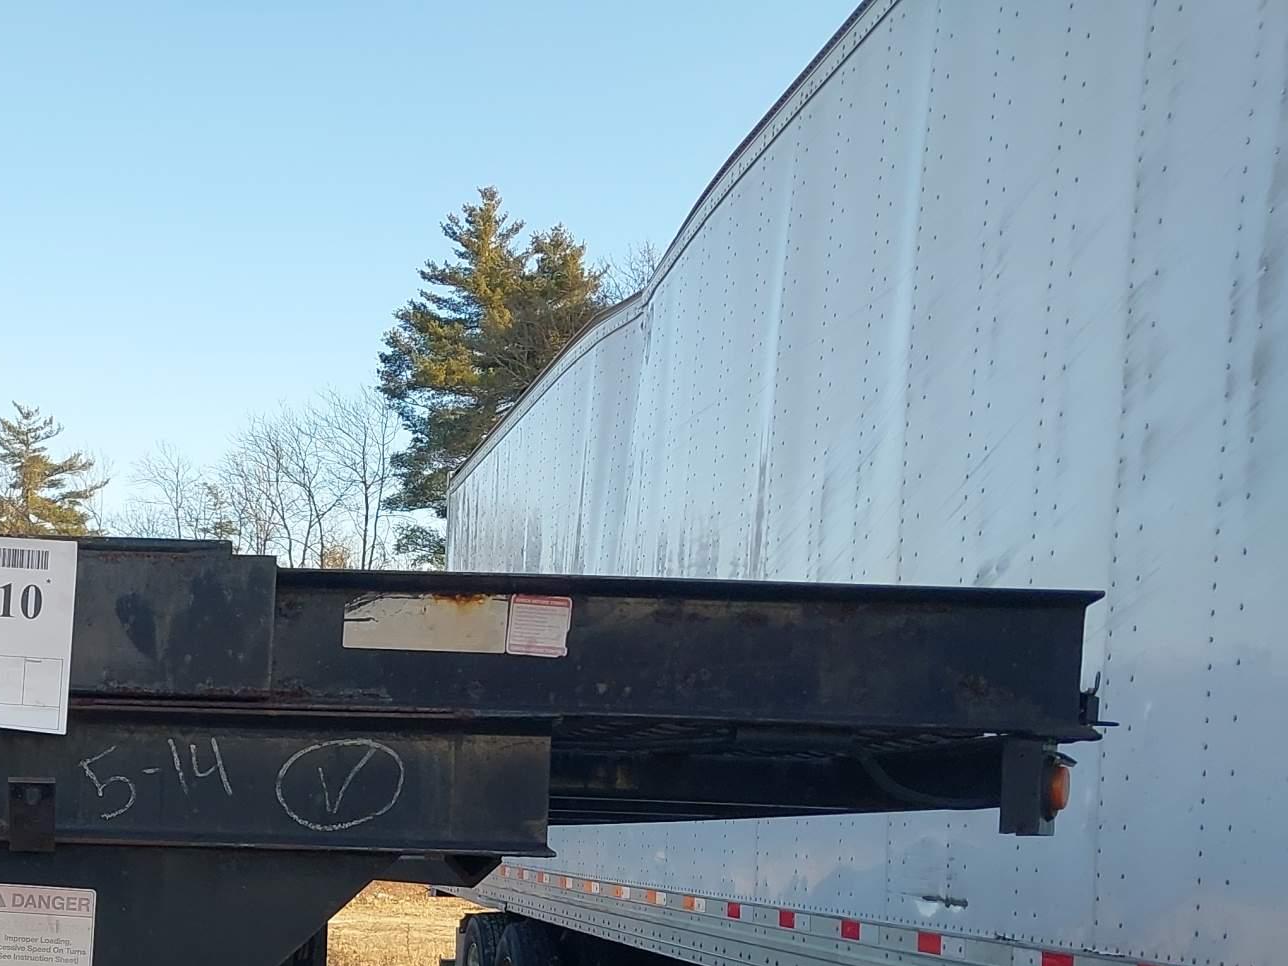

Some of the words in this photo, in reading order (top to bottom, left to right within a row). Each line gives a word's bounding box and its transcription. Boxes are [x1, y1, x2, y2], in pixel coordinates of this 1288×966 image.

[79, 738, 232, 820] 5-14
[12, 893, 90, 912] DANGER
[4, 934, 38, 944] Improper
[27, 945, 51, 954] Speed
[66, 947, 87, 955] Turns
[13, 953, 54, 962] Instruction
